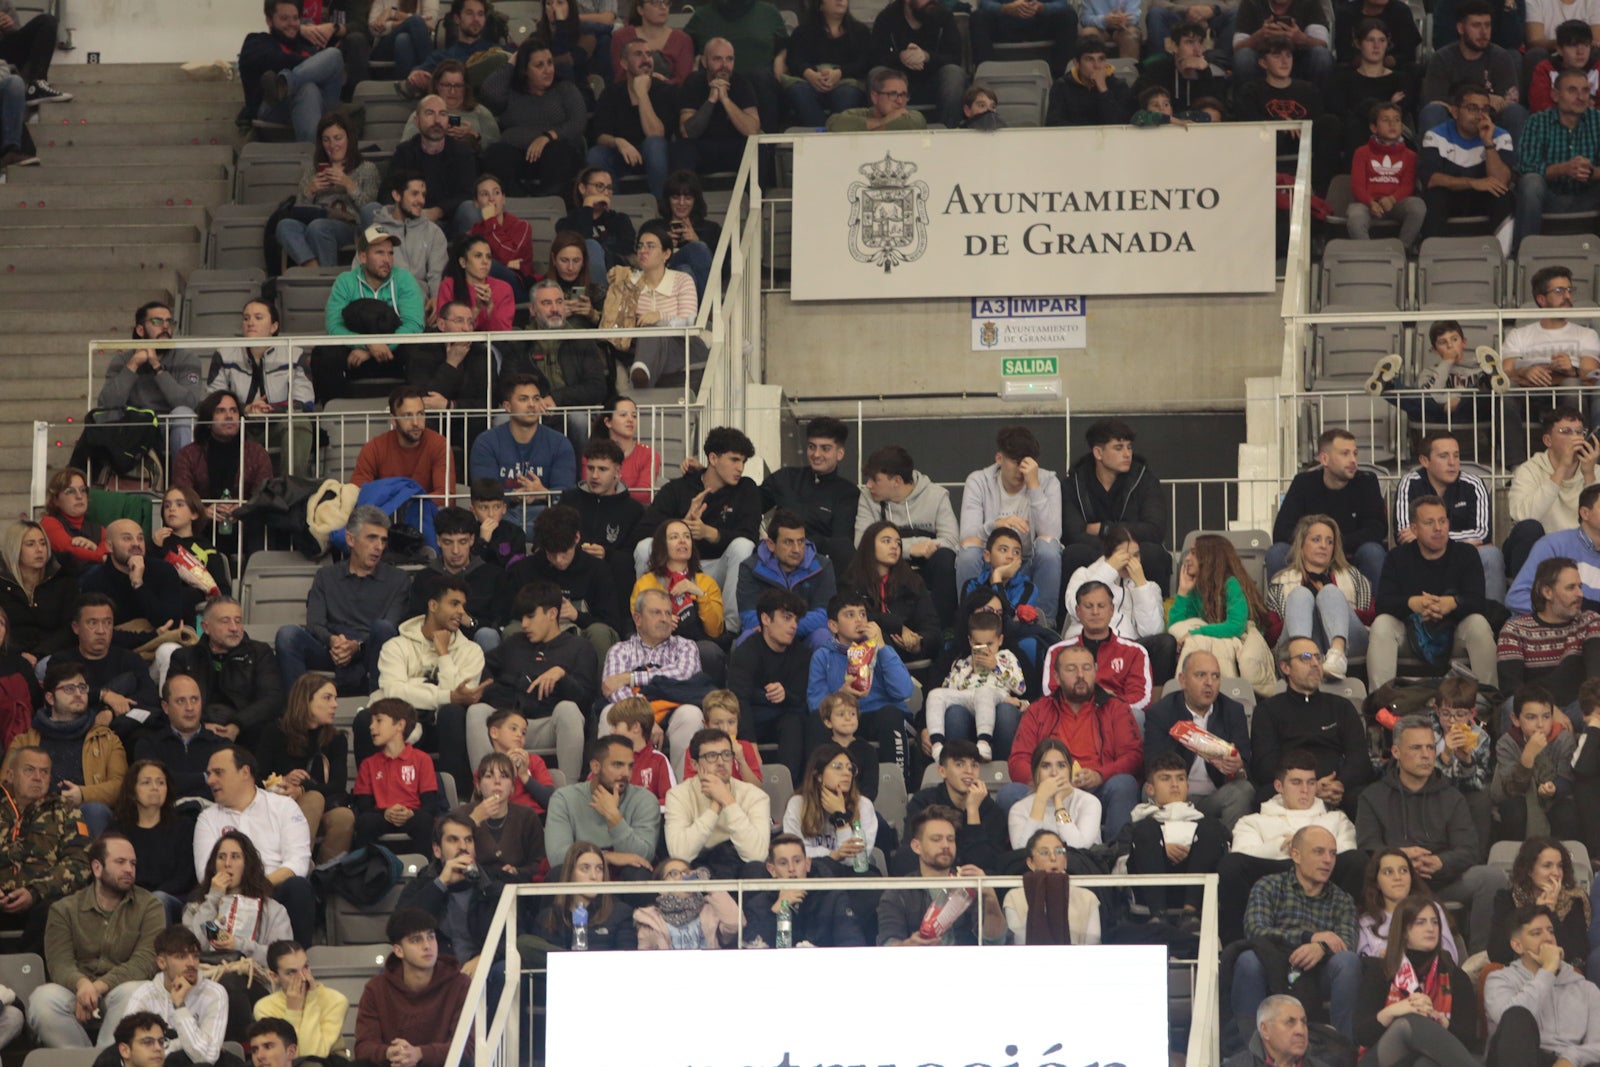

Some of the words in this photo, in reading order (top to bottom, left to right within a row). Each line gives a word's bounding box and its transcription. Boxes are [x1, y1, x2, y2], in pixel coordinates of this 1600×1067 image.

[941, 183, 1220, 215] AYUNTAMIENTO
[963, 234, 1009, 256] DE
[1022, 222, 1196, 256] GRANADA
[980, 299, 1006, 314] A3
[1013, 298, 1079, 313] IMPAR
[1005, 359, 1054, 374] SALIDA
